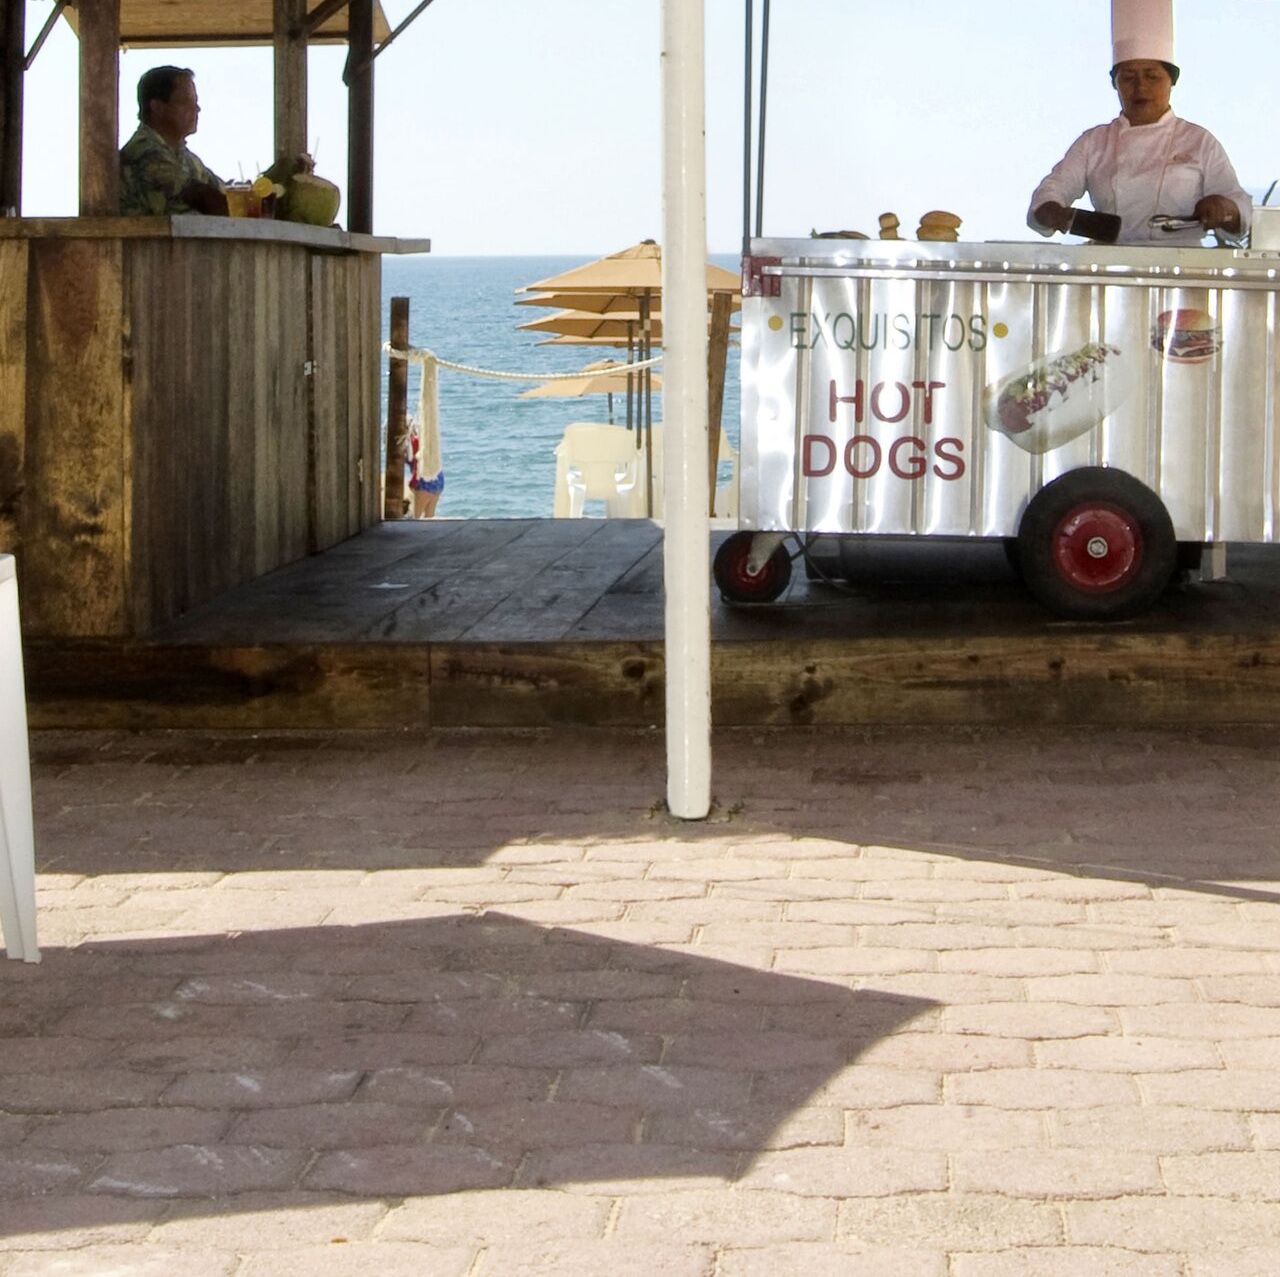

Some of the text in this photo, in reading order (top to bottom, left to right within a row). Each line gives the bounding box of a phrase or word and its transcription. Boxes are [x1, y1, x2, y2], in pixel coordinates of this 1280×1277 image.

[790, 312, 987, 352] EXQUISITOS
[829, 379, 946, 424] HOT
[802, 434, 966, 481] DOGS
